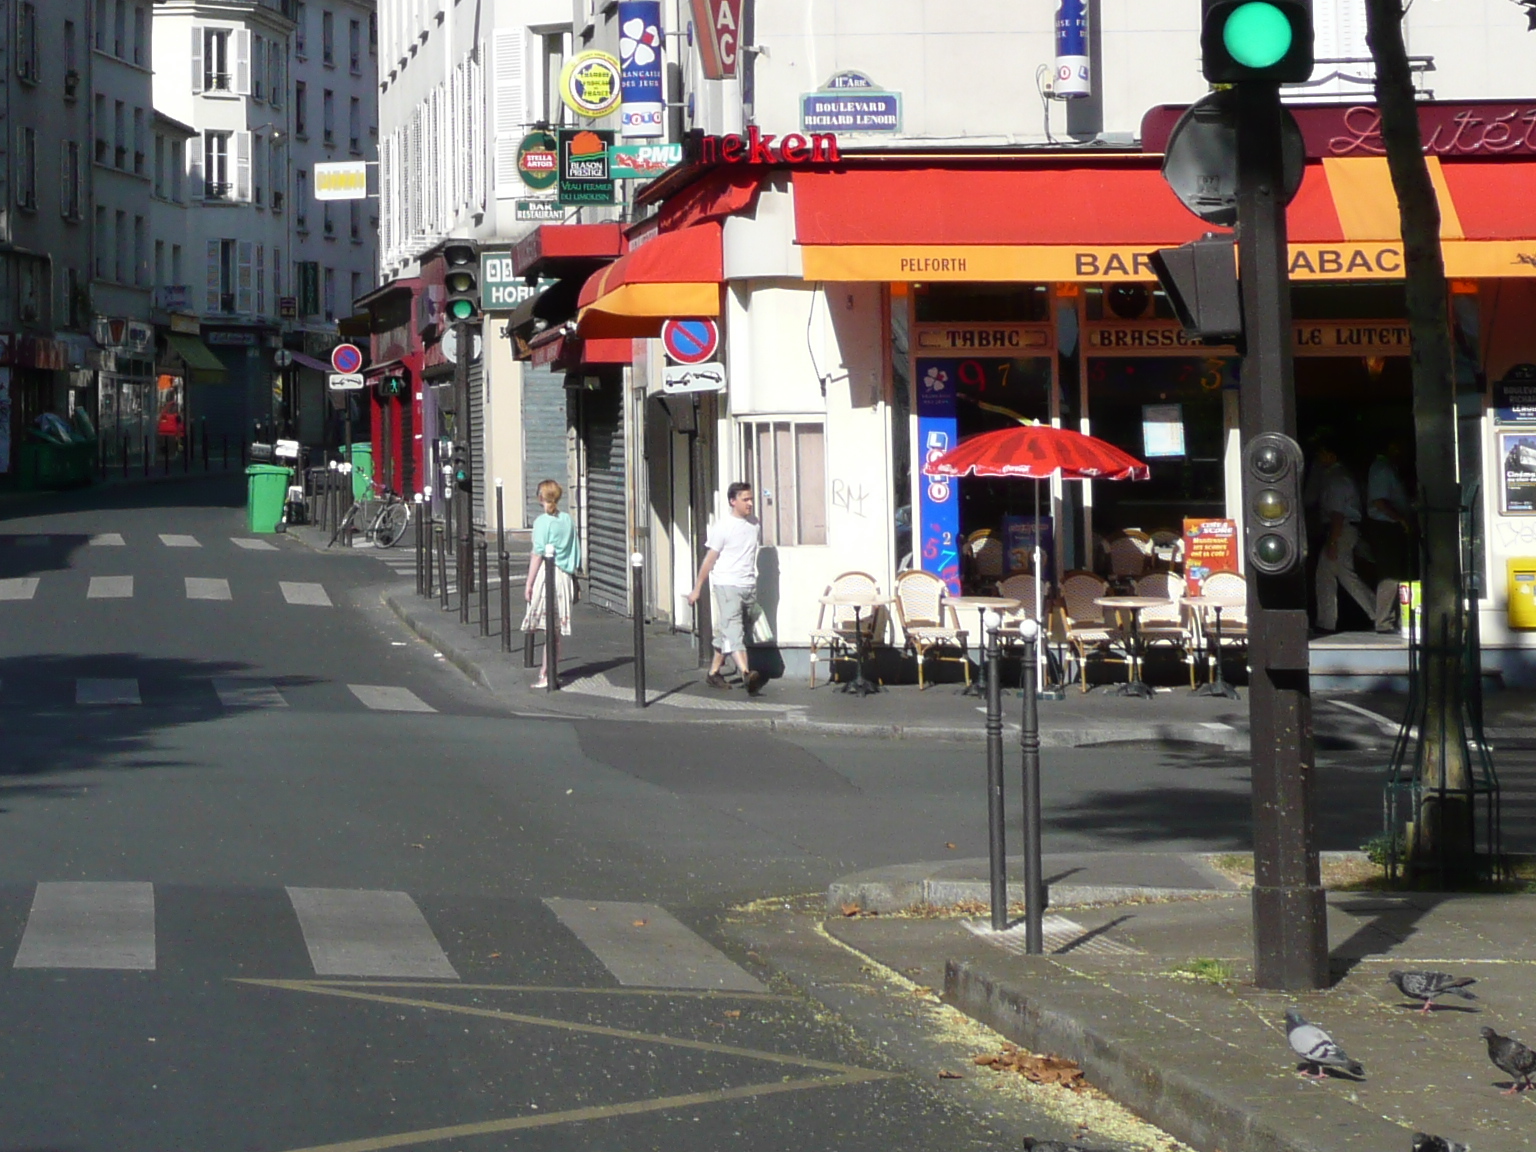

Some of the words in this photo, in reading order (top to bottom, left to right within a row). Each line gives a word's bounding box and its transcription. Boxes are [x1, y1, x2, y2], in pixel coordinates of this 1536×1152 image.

[621, 79, 636, 87] DES
[815, 101, 886, 112] BOULEVARD
[621, 111, 663, 126] LOTO
[804, 115, 854, 125] RICHARD
[856, 114, 897, 124] LENOIR
[700, 124, 842, 165] neken
[638, 146, 683, 162] PMU
[570, 161, 603, 170] BLASON
[569, 169, 603, 177] PRESTIGE
[560, 181, 582, 191] VEAU
[583, 183, 612, 191] FERMIER
[528, 202, 552, 211] BAR
[517, 210, 564, 219] RESTAURANT
[901, 258, 967, 272] PELFORTH
[1075, 252, 1157, 276] BAR
[1288, 248, 1402, 274] ABAC
[946, 330, 1020, 347] TABAC
[1297, 328, 1322, 345] LE
[942, 532, 951, 545] 2
[938, 549, 956, 572] 7
